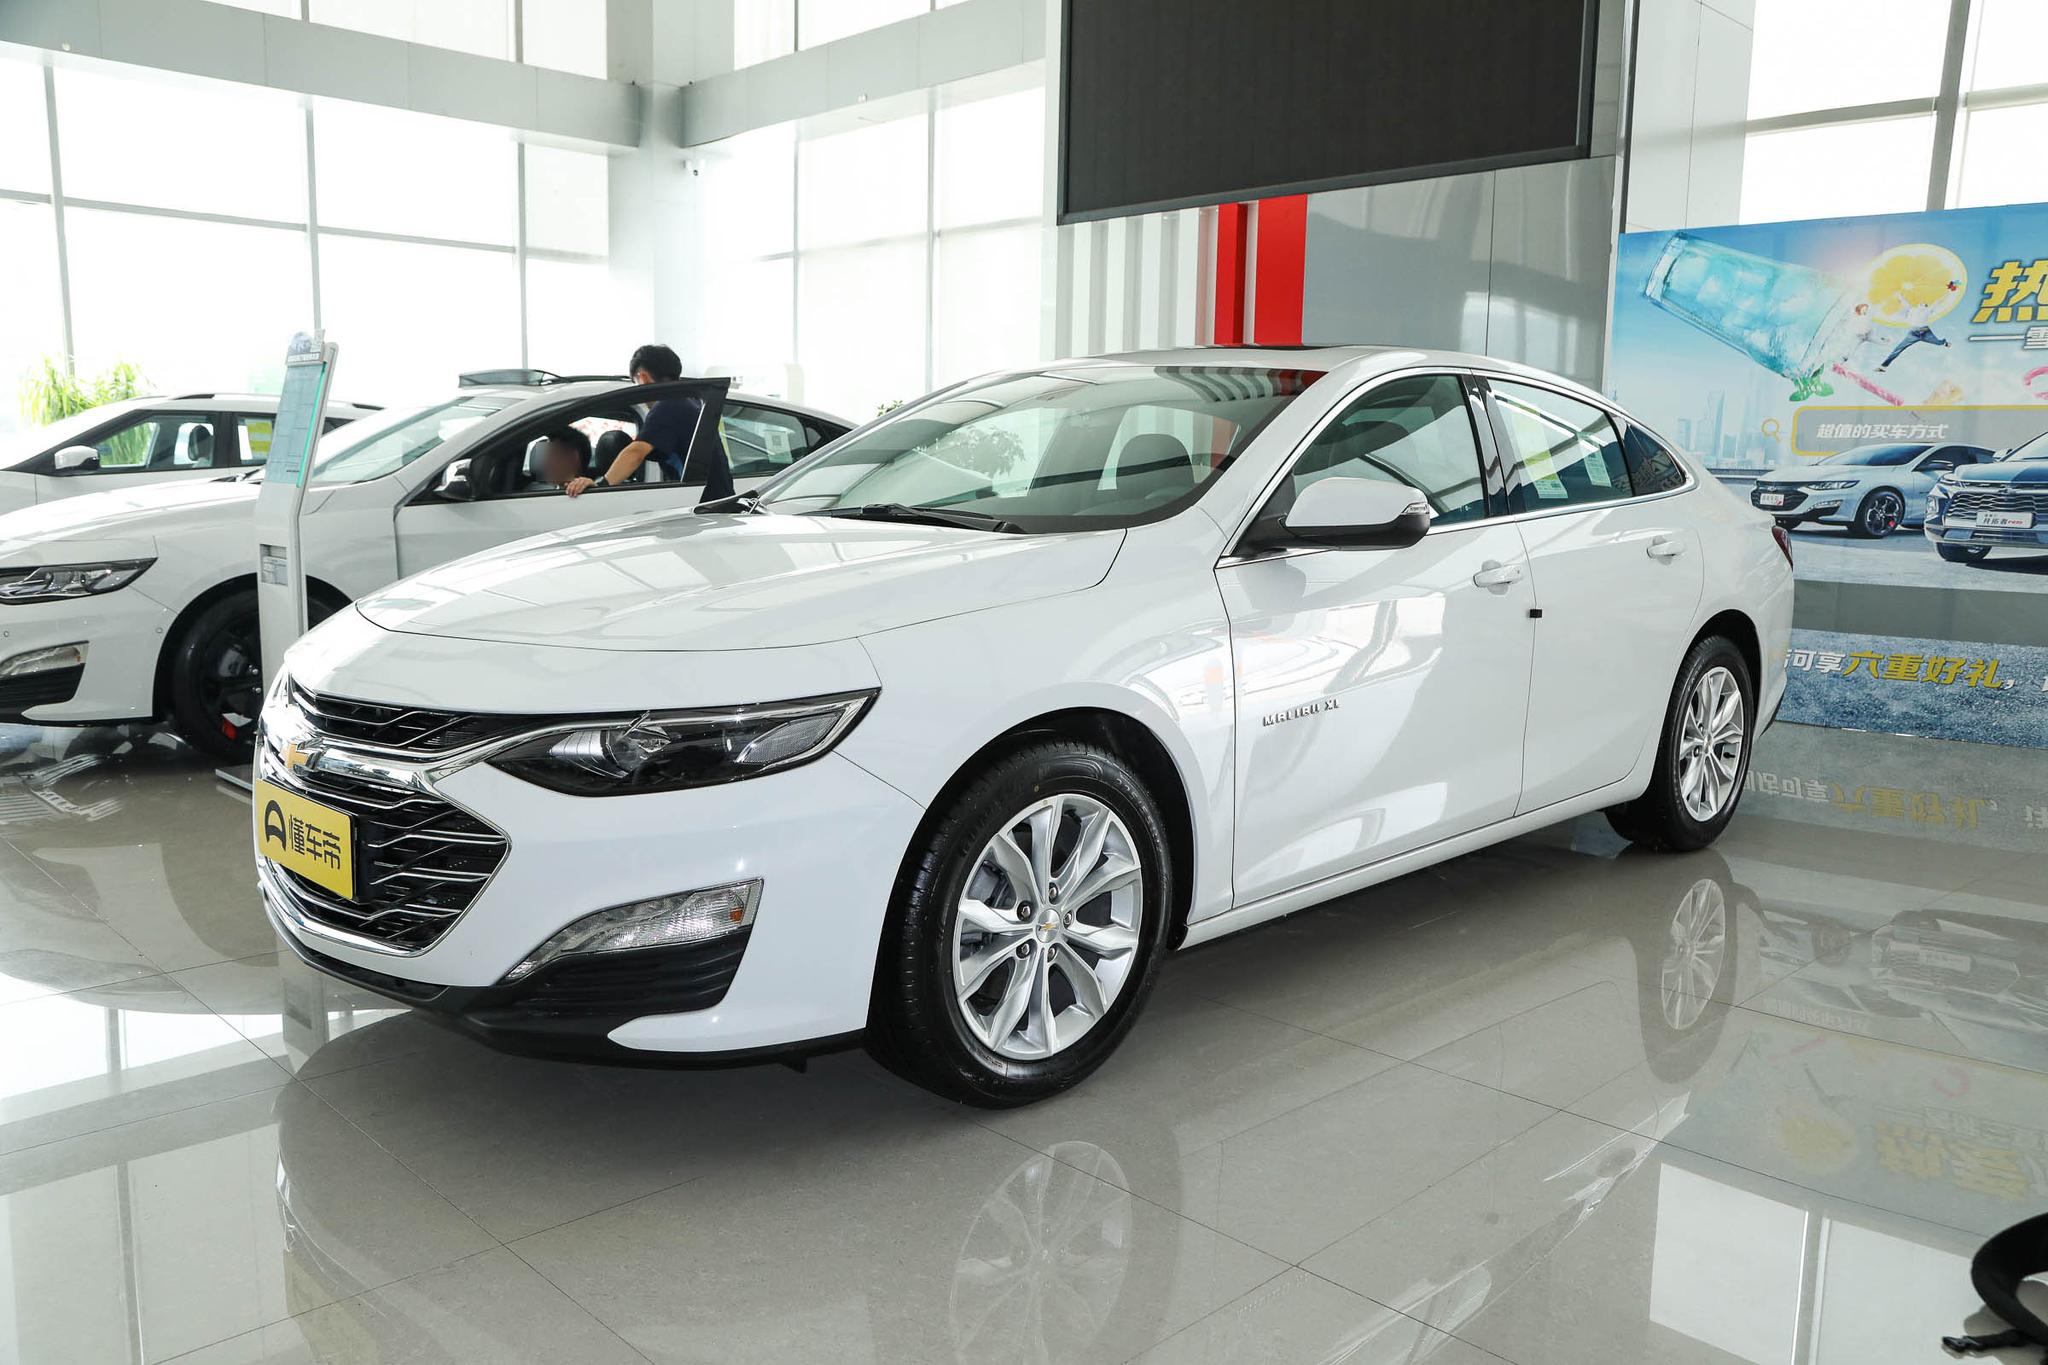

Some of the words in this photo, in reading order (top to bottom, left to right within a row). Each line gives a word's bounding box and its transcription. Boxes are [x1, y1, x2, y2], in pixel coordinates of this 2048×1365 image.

[1970, 259, 2048, 323] 热
[1816, 423, 1949, 439] 超值的买车方式
[1262, 703, 1320, 727] MALIBU
[1325, 699, 1339, 711] XL
[288, 814, 341, 870] 懂车帝
